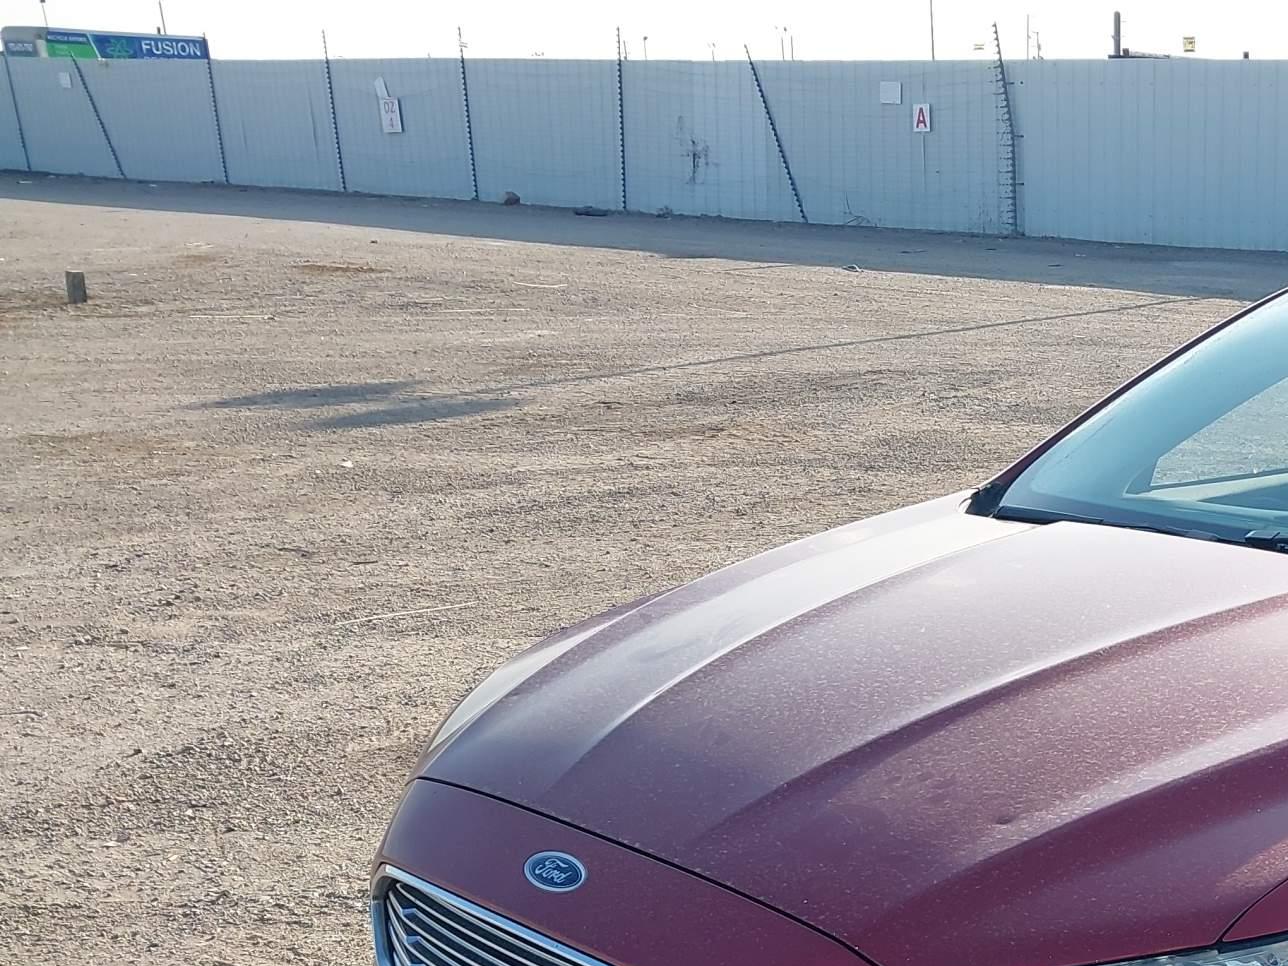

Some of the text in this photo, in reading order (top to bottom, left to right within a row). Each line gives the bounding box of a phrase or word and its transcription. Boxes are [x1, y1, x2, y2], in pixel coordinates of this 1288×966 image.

[141, 40, 201, 56] FUSION
[915, 106, 928, 129] A
[534, 857, 574, 884] Ford
